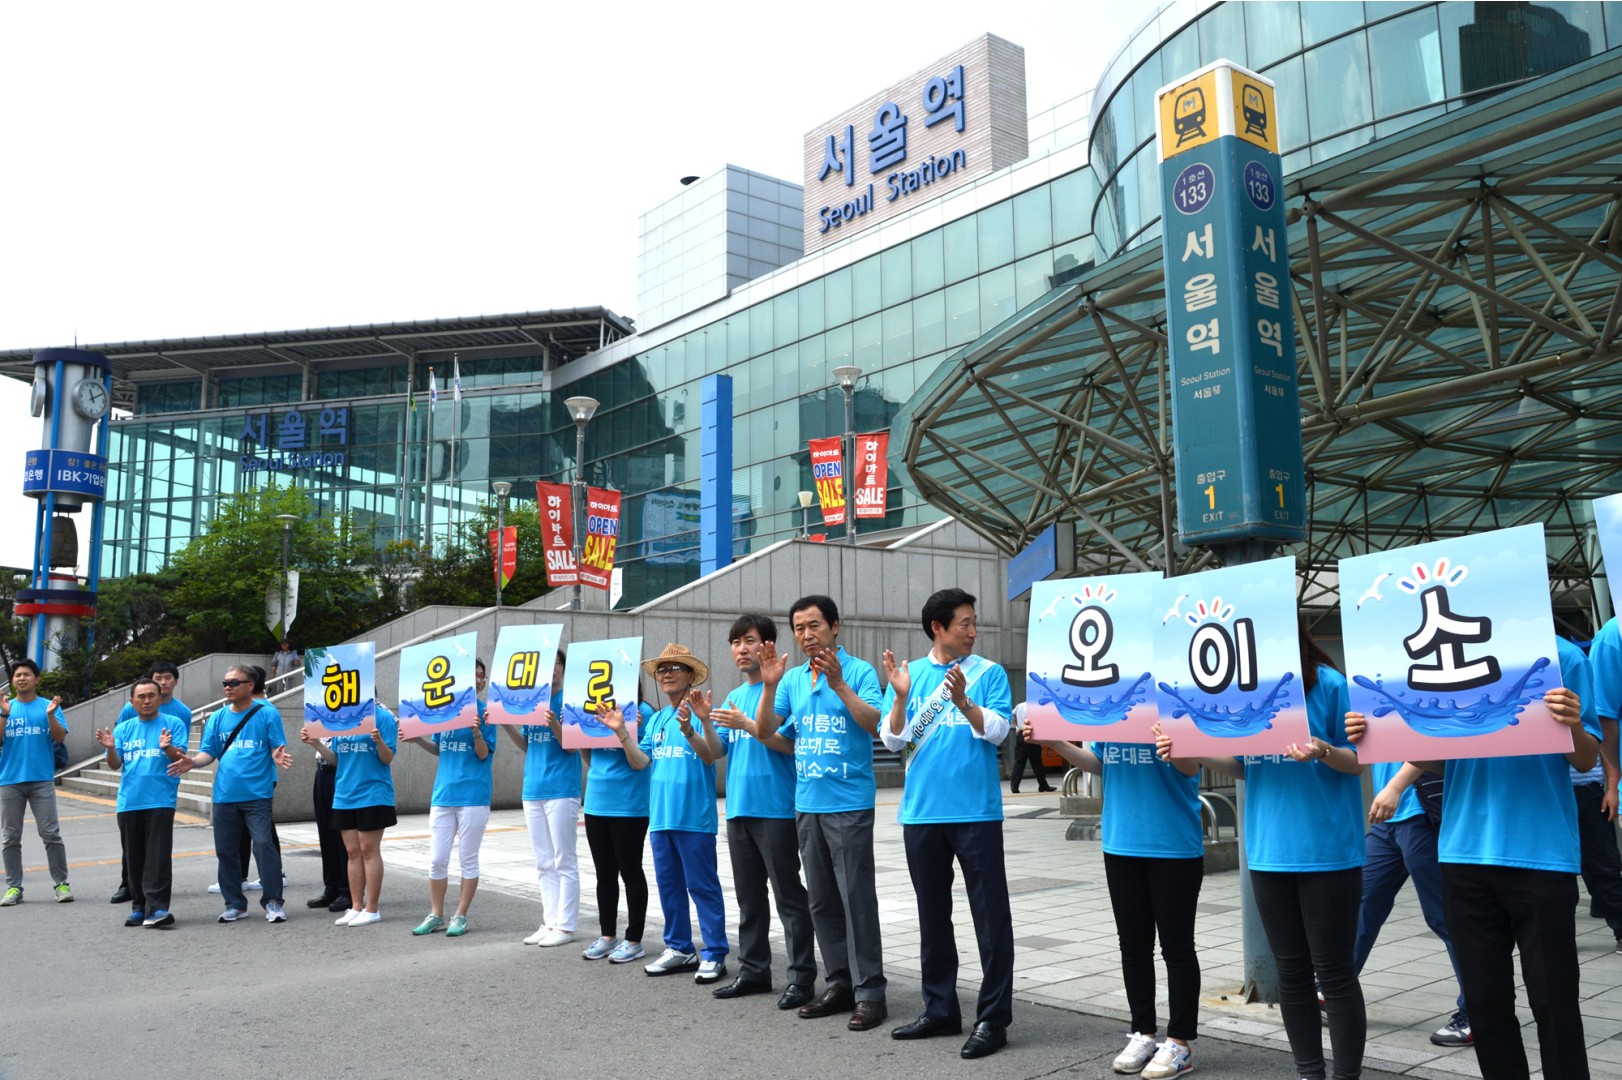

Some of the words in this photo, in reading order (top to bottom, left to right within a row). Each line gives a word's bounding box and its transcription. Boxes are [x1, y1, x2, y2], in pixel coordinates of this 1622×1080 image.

[818, 64, 965, 187] 서울역
[817, 183, 874, 233] Seoul
[886, 147, 966, 202] Station
[1180, 182, 1207, 207] 133
[1249, 180, 1270, 203] 133
[1181, 223, 1220, 355] 서울역
[1252, 225, 1282, 357] 서울역
[1180, 374, 1202, 386] Seoul
[1204, 367, 1231, 380] Station
[1254, 365, 1271, 376] Seoul
[1271, 370, 1291, 381] Station
[240, 408, 348, 450] 서울역
[240, 452, 284, 473] Seoul
[287, 449, 345, 470] Station
[813, 461, 841, 479] OPEN
[865, 441, 878, 485] 하이마트
[1197, 470, 1226, 484] 출입구
[1269, 469, 1290, 482] 출입구
[816, 478, 846, 510] SALE
[856, 487, 884, 505] SALE
[1204, 485, 1215, 509] 1
[1275, 483, 1284, 508] 1
[590, 501, 619, 513] 하이마트
[1202, 511, 1224, 523] EXIT
[1274, 510, 1289, 520] EXIT
[547, 496, 567, 547] 하이마트
[588, 514, 618, 536] OPEN
[546, 549, 576, 570] SALE
[581, 535, 616, 571] SALE
[1061, 605, 1119, 688] 오
[1403, 585, 1502, 692] 소
[1188, 617, 1258, 694] 이
[422, 655, 455, 708] 운
[506, 651, 540, 690] 대
[322, 663, 360, 712] 해
[583, 660, 616, 714] 로
[802, 713, 847, 733] 여름엔
[795, 760, 848, 779] 이소~!
